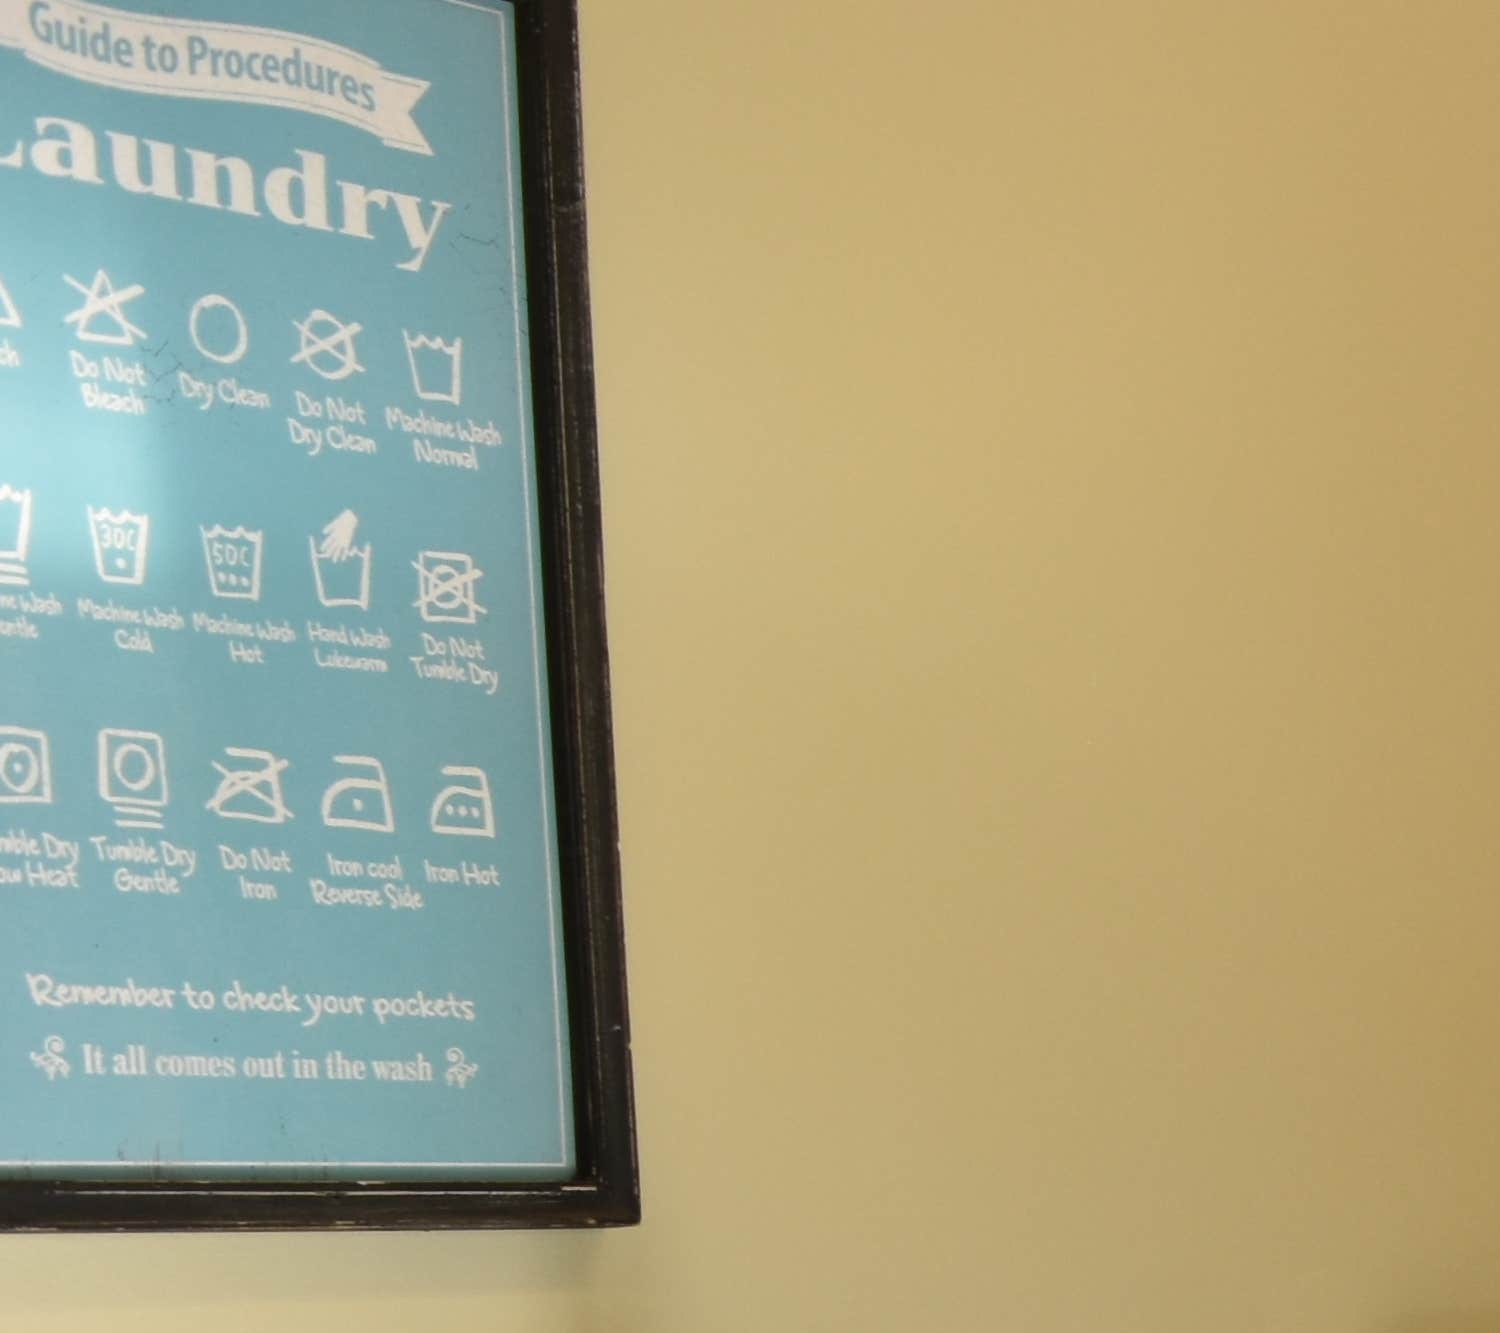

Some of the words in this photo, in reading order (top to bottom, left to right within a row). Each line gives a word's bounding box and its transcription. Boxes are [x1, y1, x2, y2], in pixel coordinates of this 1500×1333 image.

[29, 1, 133, 68] Guide
[142, 35, 179, 74] to
[187, 38, 376, 113] Procedures
[69, 349, 98, 378] Do
[103, 356, 147, 387] Not
[81, 382, 146, 415] Bleach
[177, 370, 213, 411] Dry
[217, 377, 271, 408] Clean
[295, 390, 322, 417] Do
[325, 396, 366, 425] Not
[385, 406, 455, 438] Machine
[287, 417, 322, 456] Dry
[326, 425, 376, 454] Clean
[413, 438, 479, 470] Normal
[77, 597, 142, 624] Machine
[192, 612, 255, 637] Machine
[0, 615, 39, 639] entle
[114, 628, 154, 653] Cold
[306, 620, 348, 645] Hand
[229, 640, 264, 663] Hot
[314, 648, 389, 672] Lukewarm
[421, 632, 446, 656] Do
[450, 636, 485, 660] Not
[409, 656, 466, 682] Tumble
[468, 662, 498, 695] Dry
[0, 829, 41, 856] mble
[41, 832, 79, 869] Dry
[89, 835, 158, 863] Tumble
[160, 841, 196, 877] Dry
[218, 844, 247, 870] Do
[251, 847, 293, 873] Not
[25, 861, 79, 887] Heat
[114, 867, 180, 893] Gentle
[327, 853, 364, 877] Iron
[424, 859, 459, 883] Iron
[461, 860, 501, 886] Hot
[239, 875, 278, 899] Iron
[310, 878, 383, 906] Reverse
[384, 882, 424, 910] Side
[26, 972, 175, 1009] Remember
[181, 981, 215, 1011] to
[222, 980, 301, 1013] check
[301, 992, 366, 1027] your
[373, 990, 476, 1024] pockets
[81, 1043, 105, 1076] It
[113, 1044, 147, 1077] all
[154, 1050, 236, 1079] comes
[243, 1052, 286, 1080] out
[292, 1049, 320, 1080] in
[325, 1050, 366, 1082] the
[372, 1053, 434, 1082] wash
